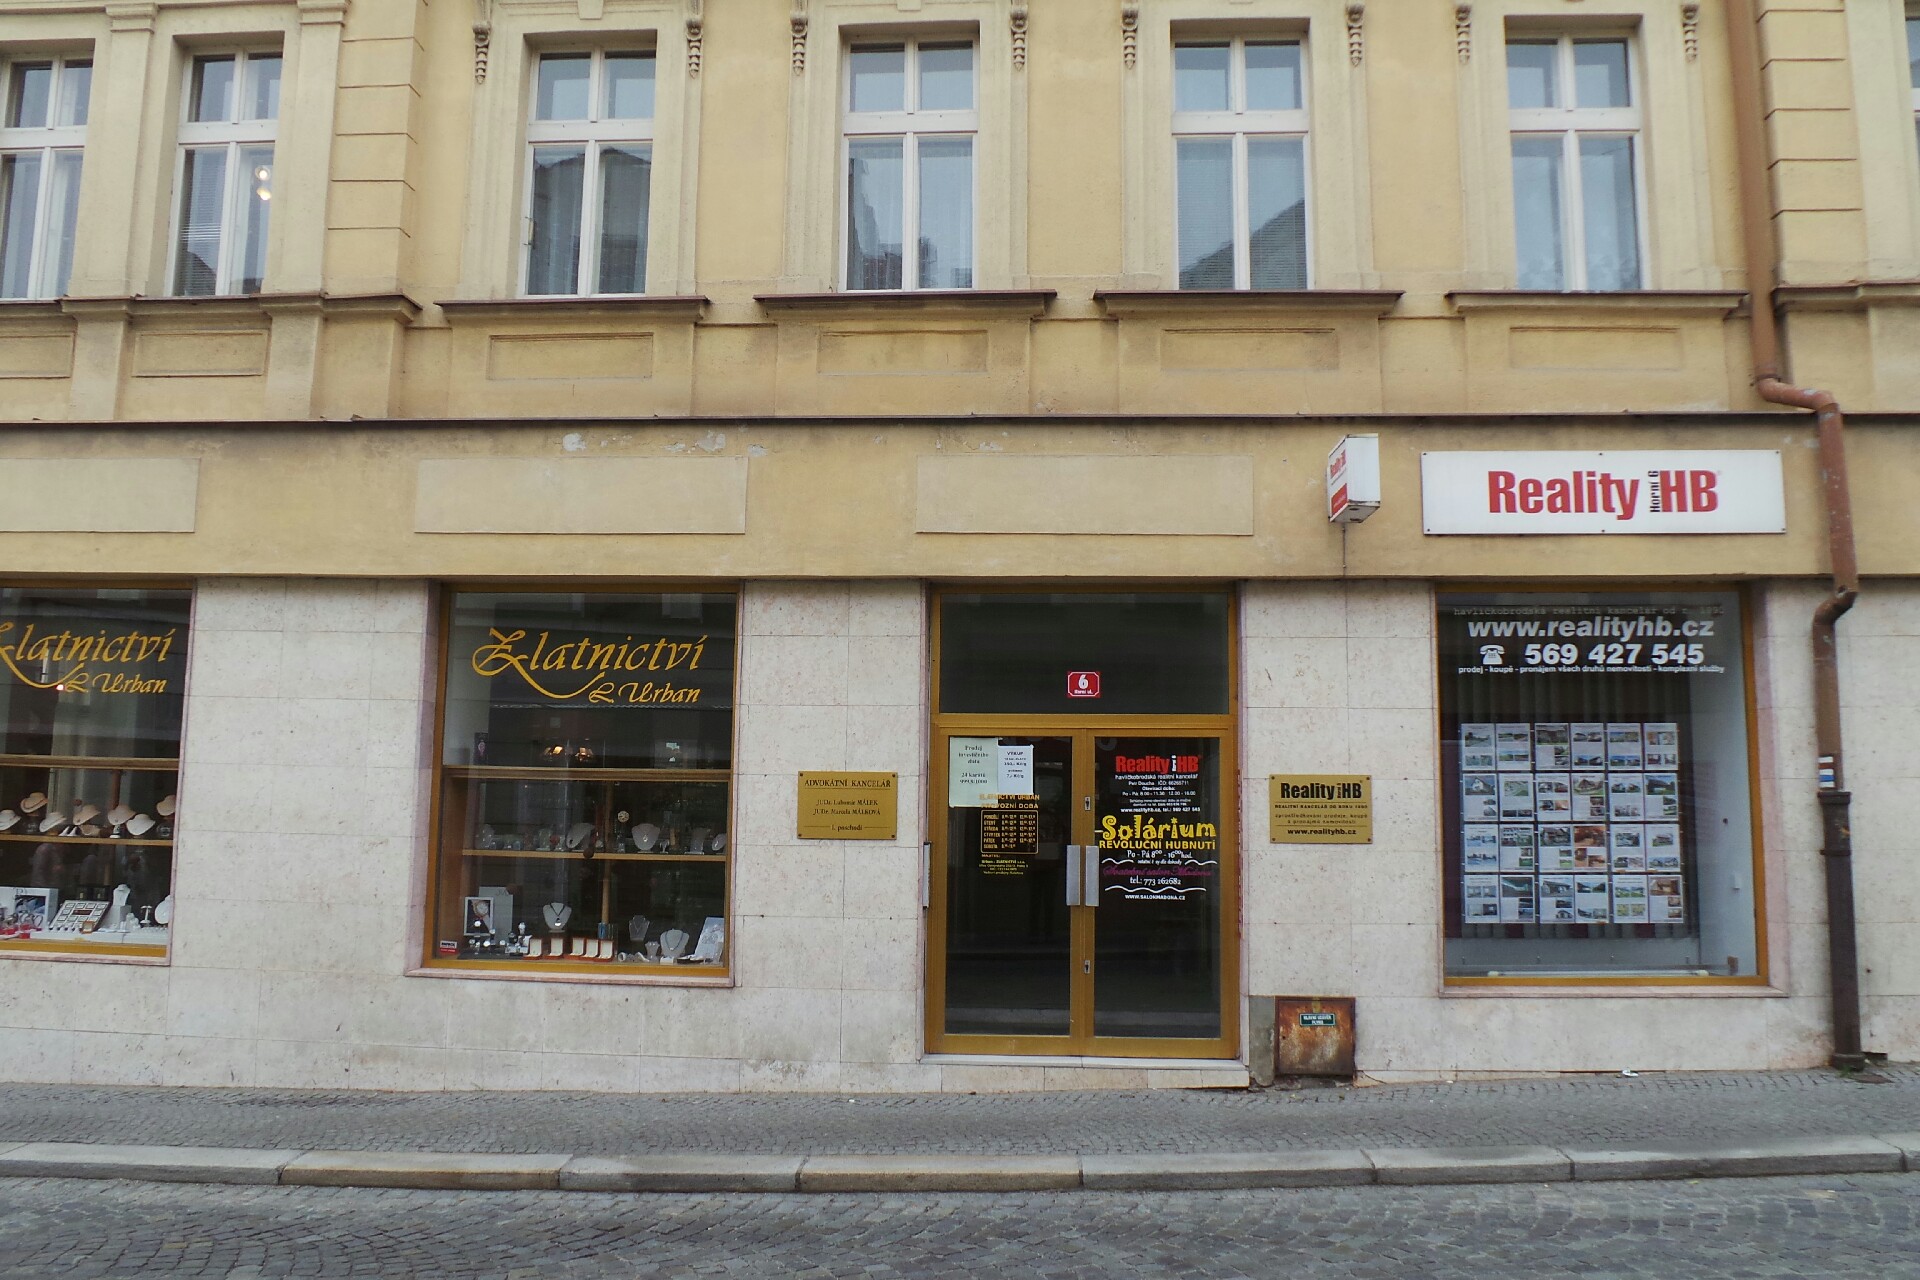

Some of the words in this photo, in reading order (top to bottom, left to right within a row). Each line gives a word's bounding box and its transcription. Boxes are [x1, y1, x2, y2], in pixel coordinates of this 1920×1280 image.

[1648, 470, 1659, 478] 6
[1488, 470, 1640, 520] Reality
[1659, 470, 1719, 513] HB
[1650, 481, 1661, 513] Horní
[1467, 615, 1715, 642] www.realityhb.cz
[471, 627, 708, 699] Zlatnictví
[1524, 643, 1578, 665] 569
[1587, 643, 1642, 665] 427
[1650, 643, 1704, 665] 545
[1458, 665, 1484, 674] prodej
[1489, 665, 1514, 674] koupě
[92, 672, 168, 694] Urban
[1078, 674, 1089, 690] 6
[617, 681, 701, 704] Urban
[1115, 755, 1170, 774] Reality
[1176, 755, 1199, 773] HB
[804, 778, 848, 787] ADVOKÁTNÍ
[851, 779, 891, 788] KANCELÁŘ
[1280, 782, 1335, 800] Reality
[1341, 782, 1362, 799] HB
[857, 798, 878, 806] MÁLEK
[1101, 814, 1217, 841] Solárium
[1287, 828, 1357, 836] www.realityhb.cz
[1099, 838, 1162, 849] REVOLUČNÍ
[1165, 839, 1216, 850] HUBNUTÍ
[1127, 850, 1136, 858] Po
[1141, 850, 1151, 858] Pá
[1143, 877, 1156, 886] 773
